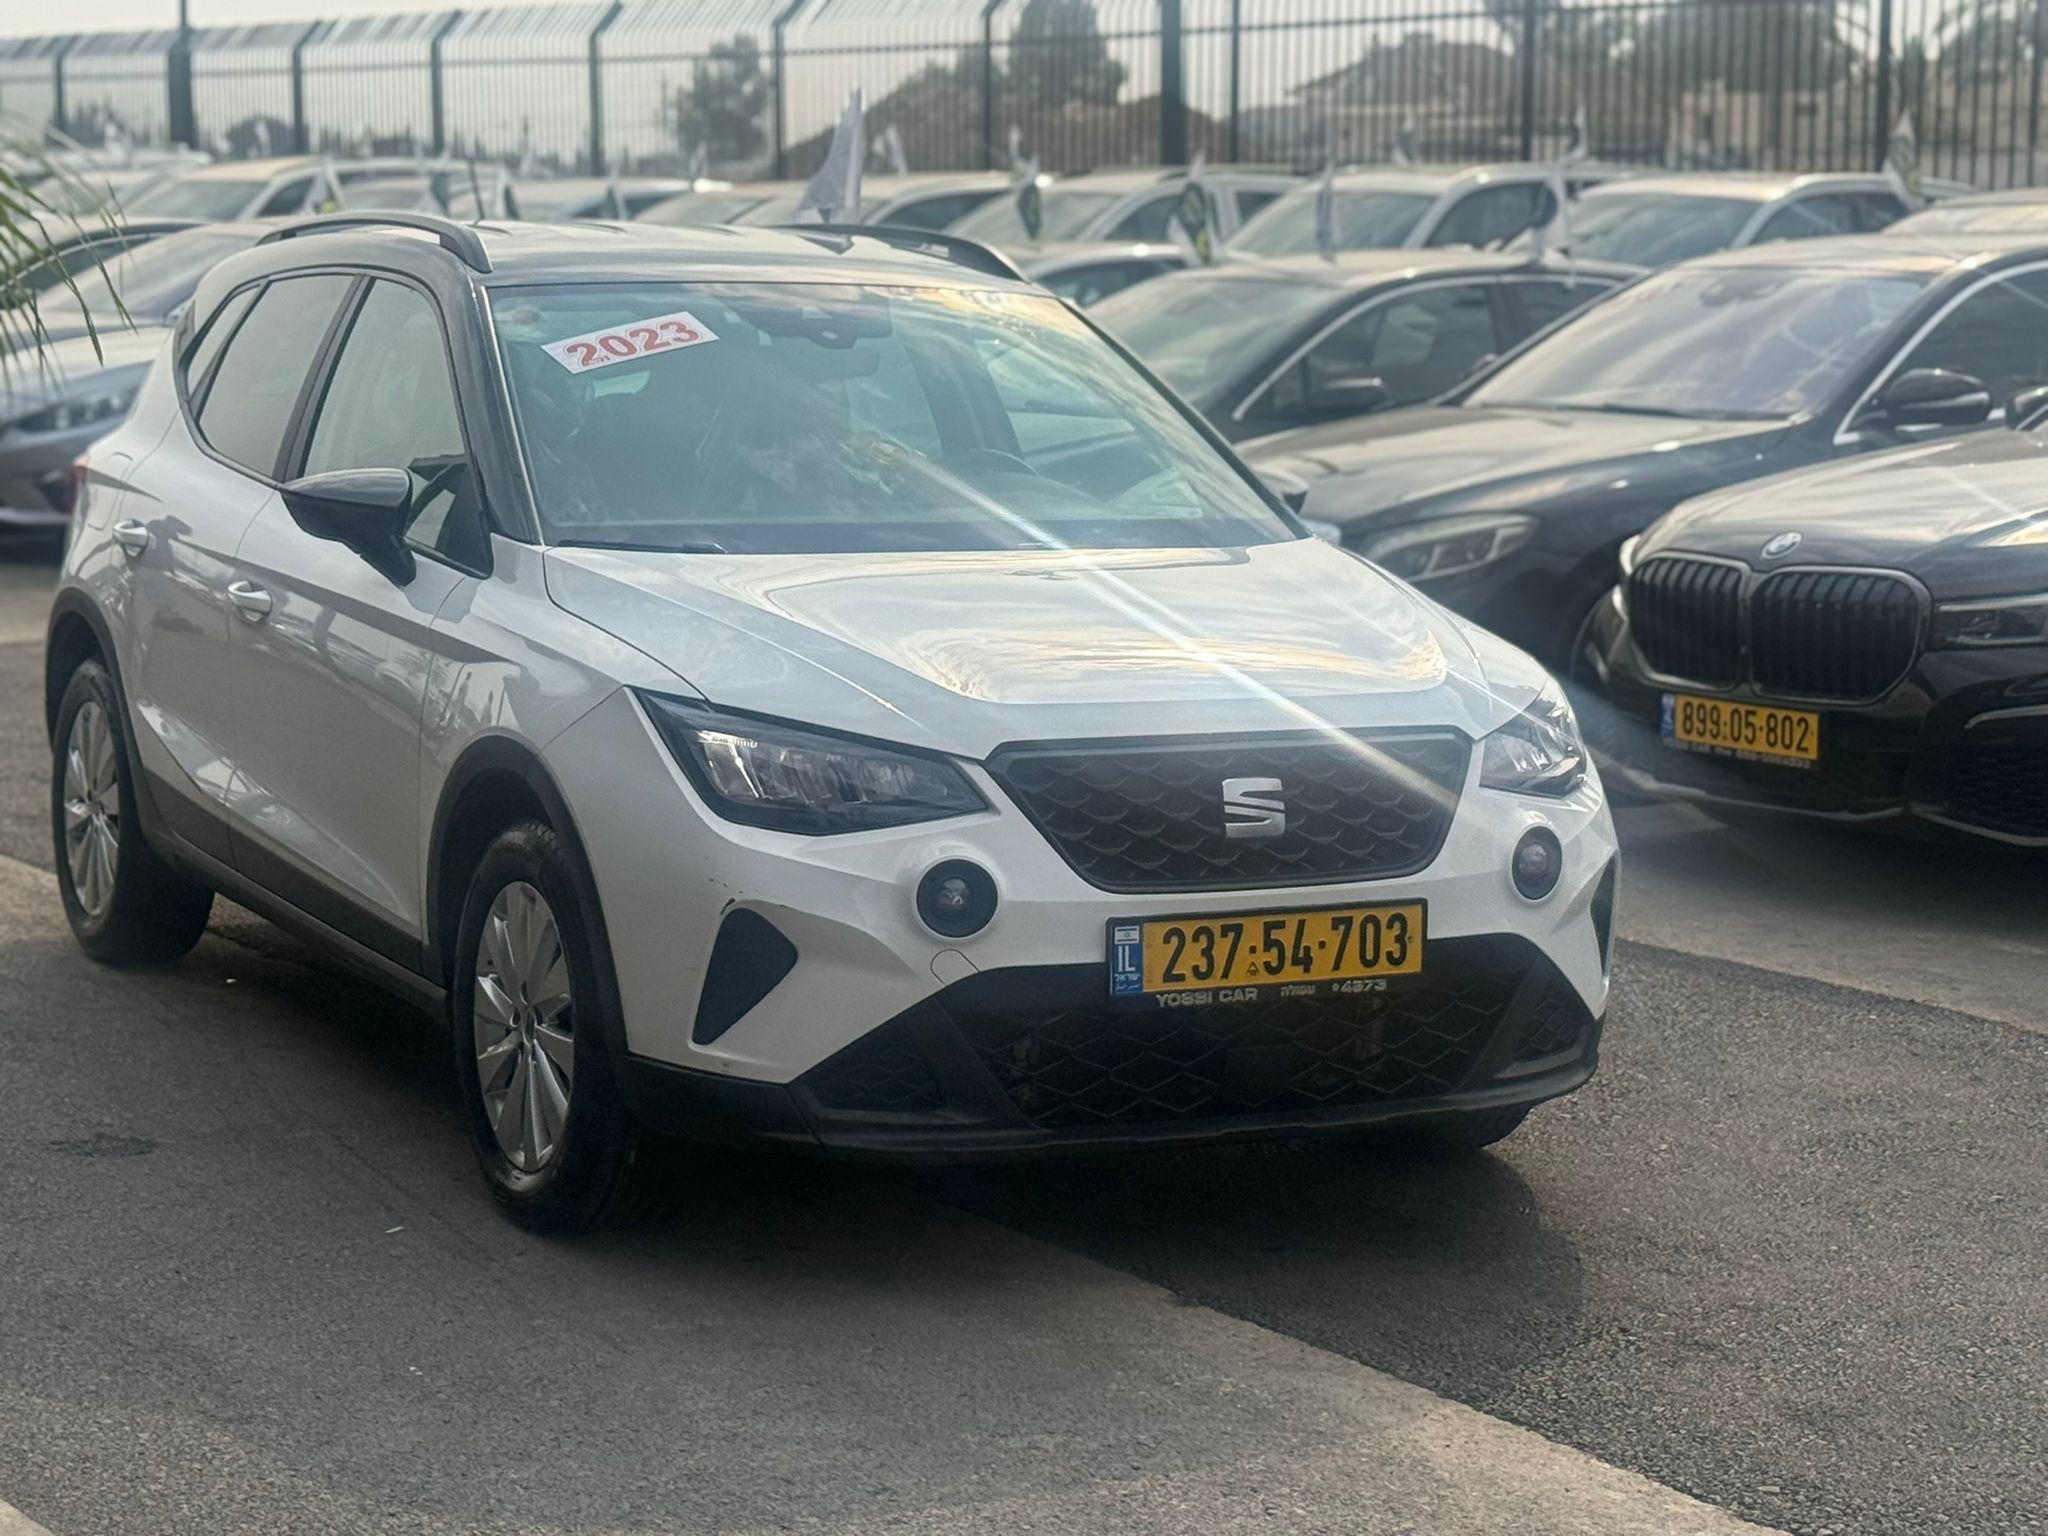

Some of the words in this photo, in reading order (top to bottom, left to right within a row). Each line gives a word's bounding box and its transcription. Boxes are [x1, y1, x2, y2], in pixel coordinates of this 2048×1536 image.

[566, 321, 700, 367] 2023
[1117, 945, 1136, 972] IL
[1219, 987, 1258, 1002] CAR
